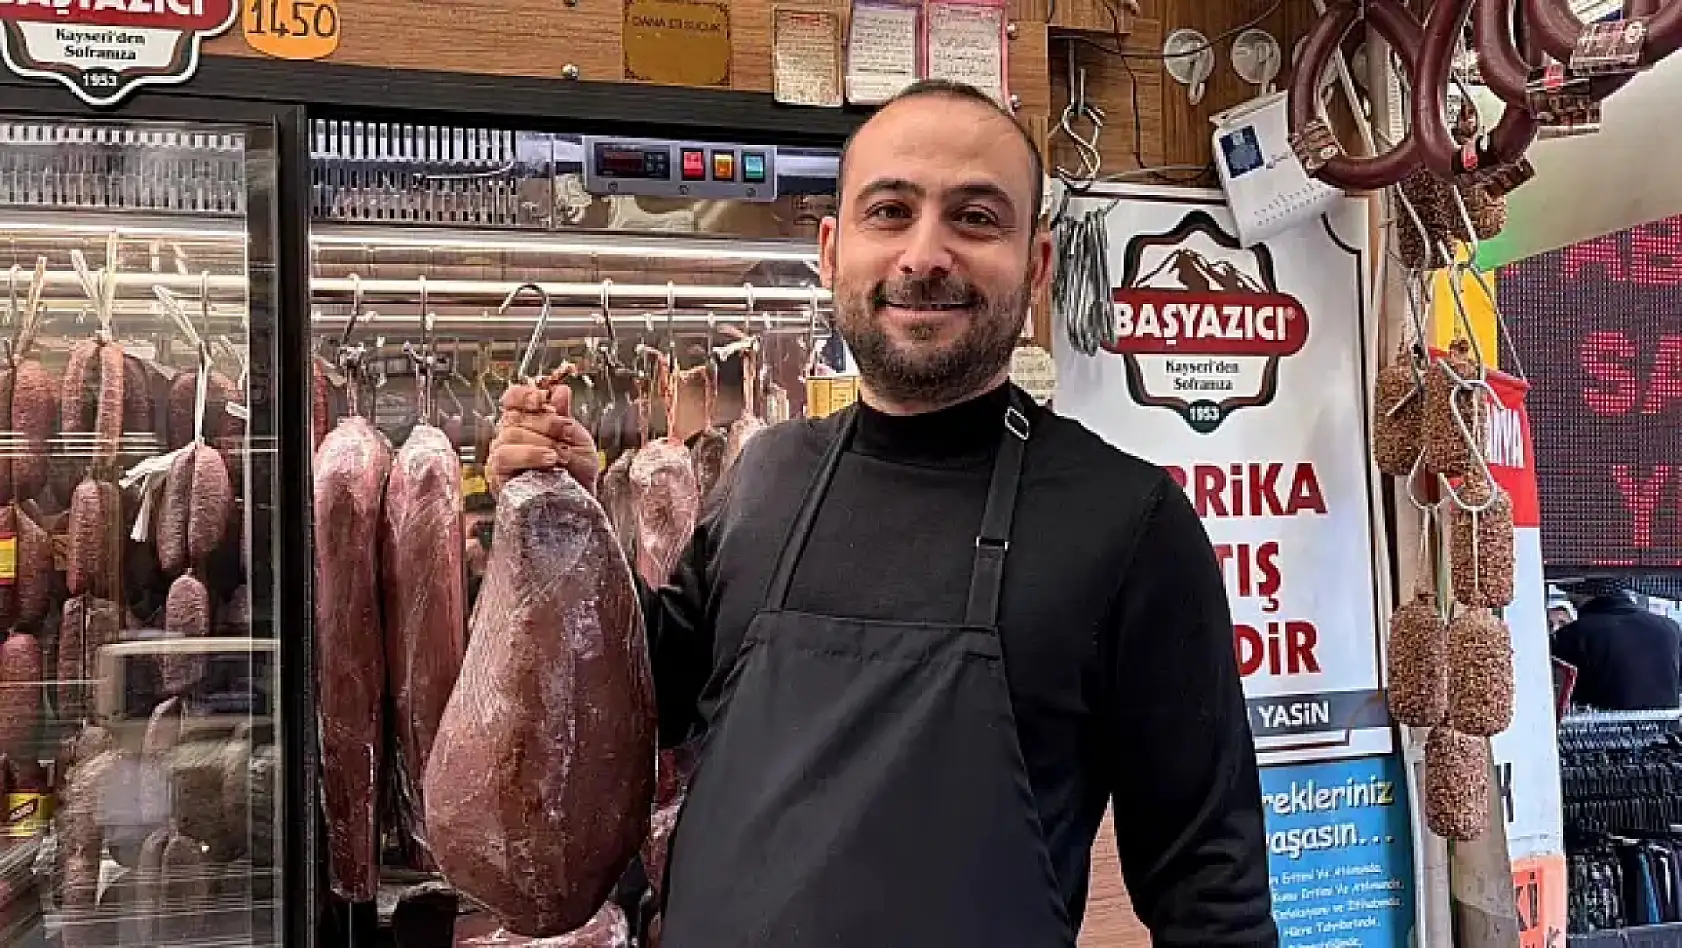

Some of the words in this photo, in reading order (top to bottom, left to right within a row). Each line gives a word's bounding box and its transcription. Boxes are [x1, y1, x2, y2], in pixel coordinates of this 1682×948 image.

[249, 2, 337, 37] 1450
[56, 28, 146, 46] Kayseri'den
[82, 74, 117, 88] 1953
[1113, 302, 1287, 346] BAŞYAZICI
[1166, 359, 1239, 376] Kayseri'den
[1257, 701, 1330, 728] YASİN
[1266, 822, 1395, 860] aşasın...
